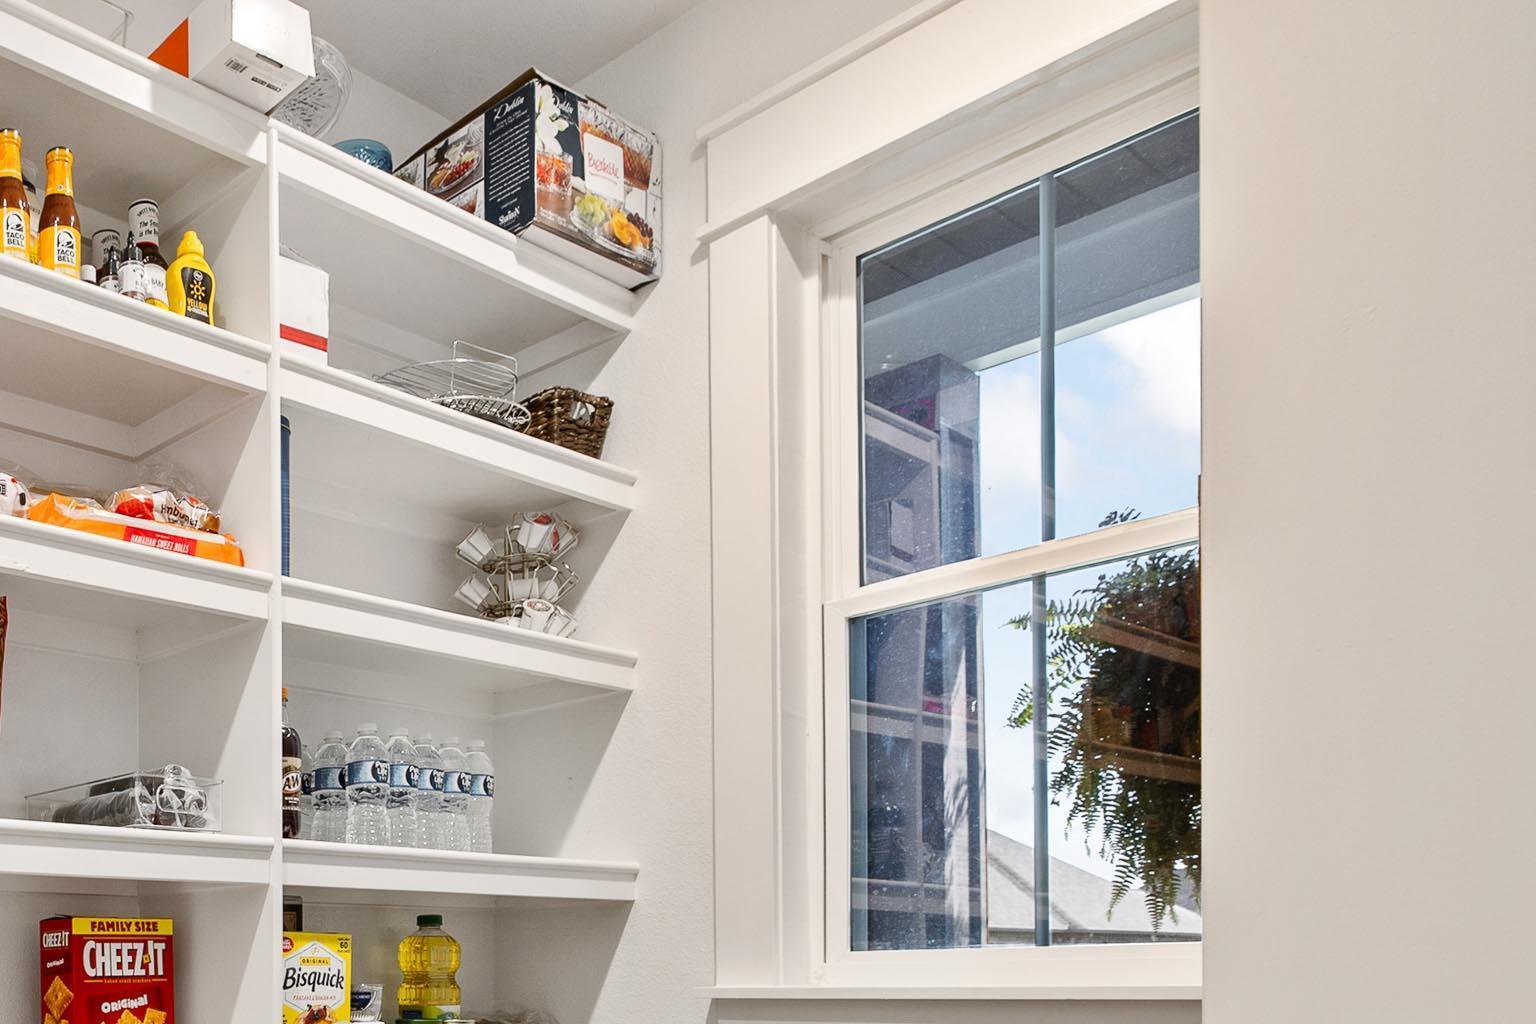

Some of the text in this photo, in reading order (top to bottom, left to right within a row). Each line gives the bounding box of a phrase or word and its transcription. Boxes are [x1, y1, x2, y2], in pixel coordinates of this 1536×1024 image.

[493, 95, 524, 122] Dublin
[6, 231, 24, 241] TACO
[7, 239, 24, 247] BELL
[57, 249, 75, 258] TACO
[58, 255, 74, 264] BELL
[187, 299, 208, 311] YELLOW
[131, 535, 189, 553] HAWAIIAN SWEET ROLLS
[91, 921, 159, 932] FAMILY SIZE
[283, 967, 344, 992] Bisquick
